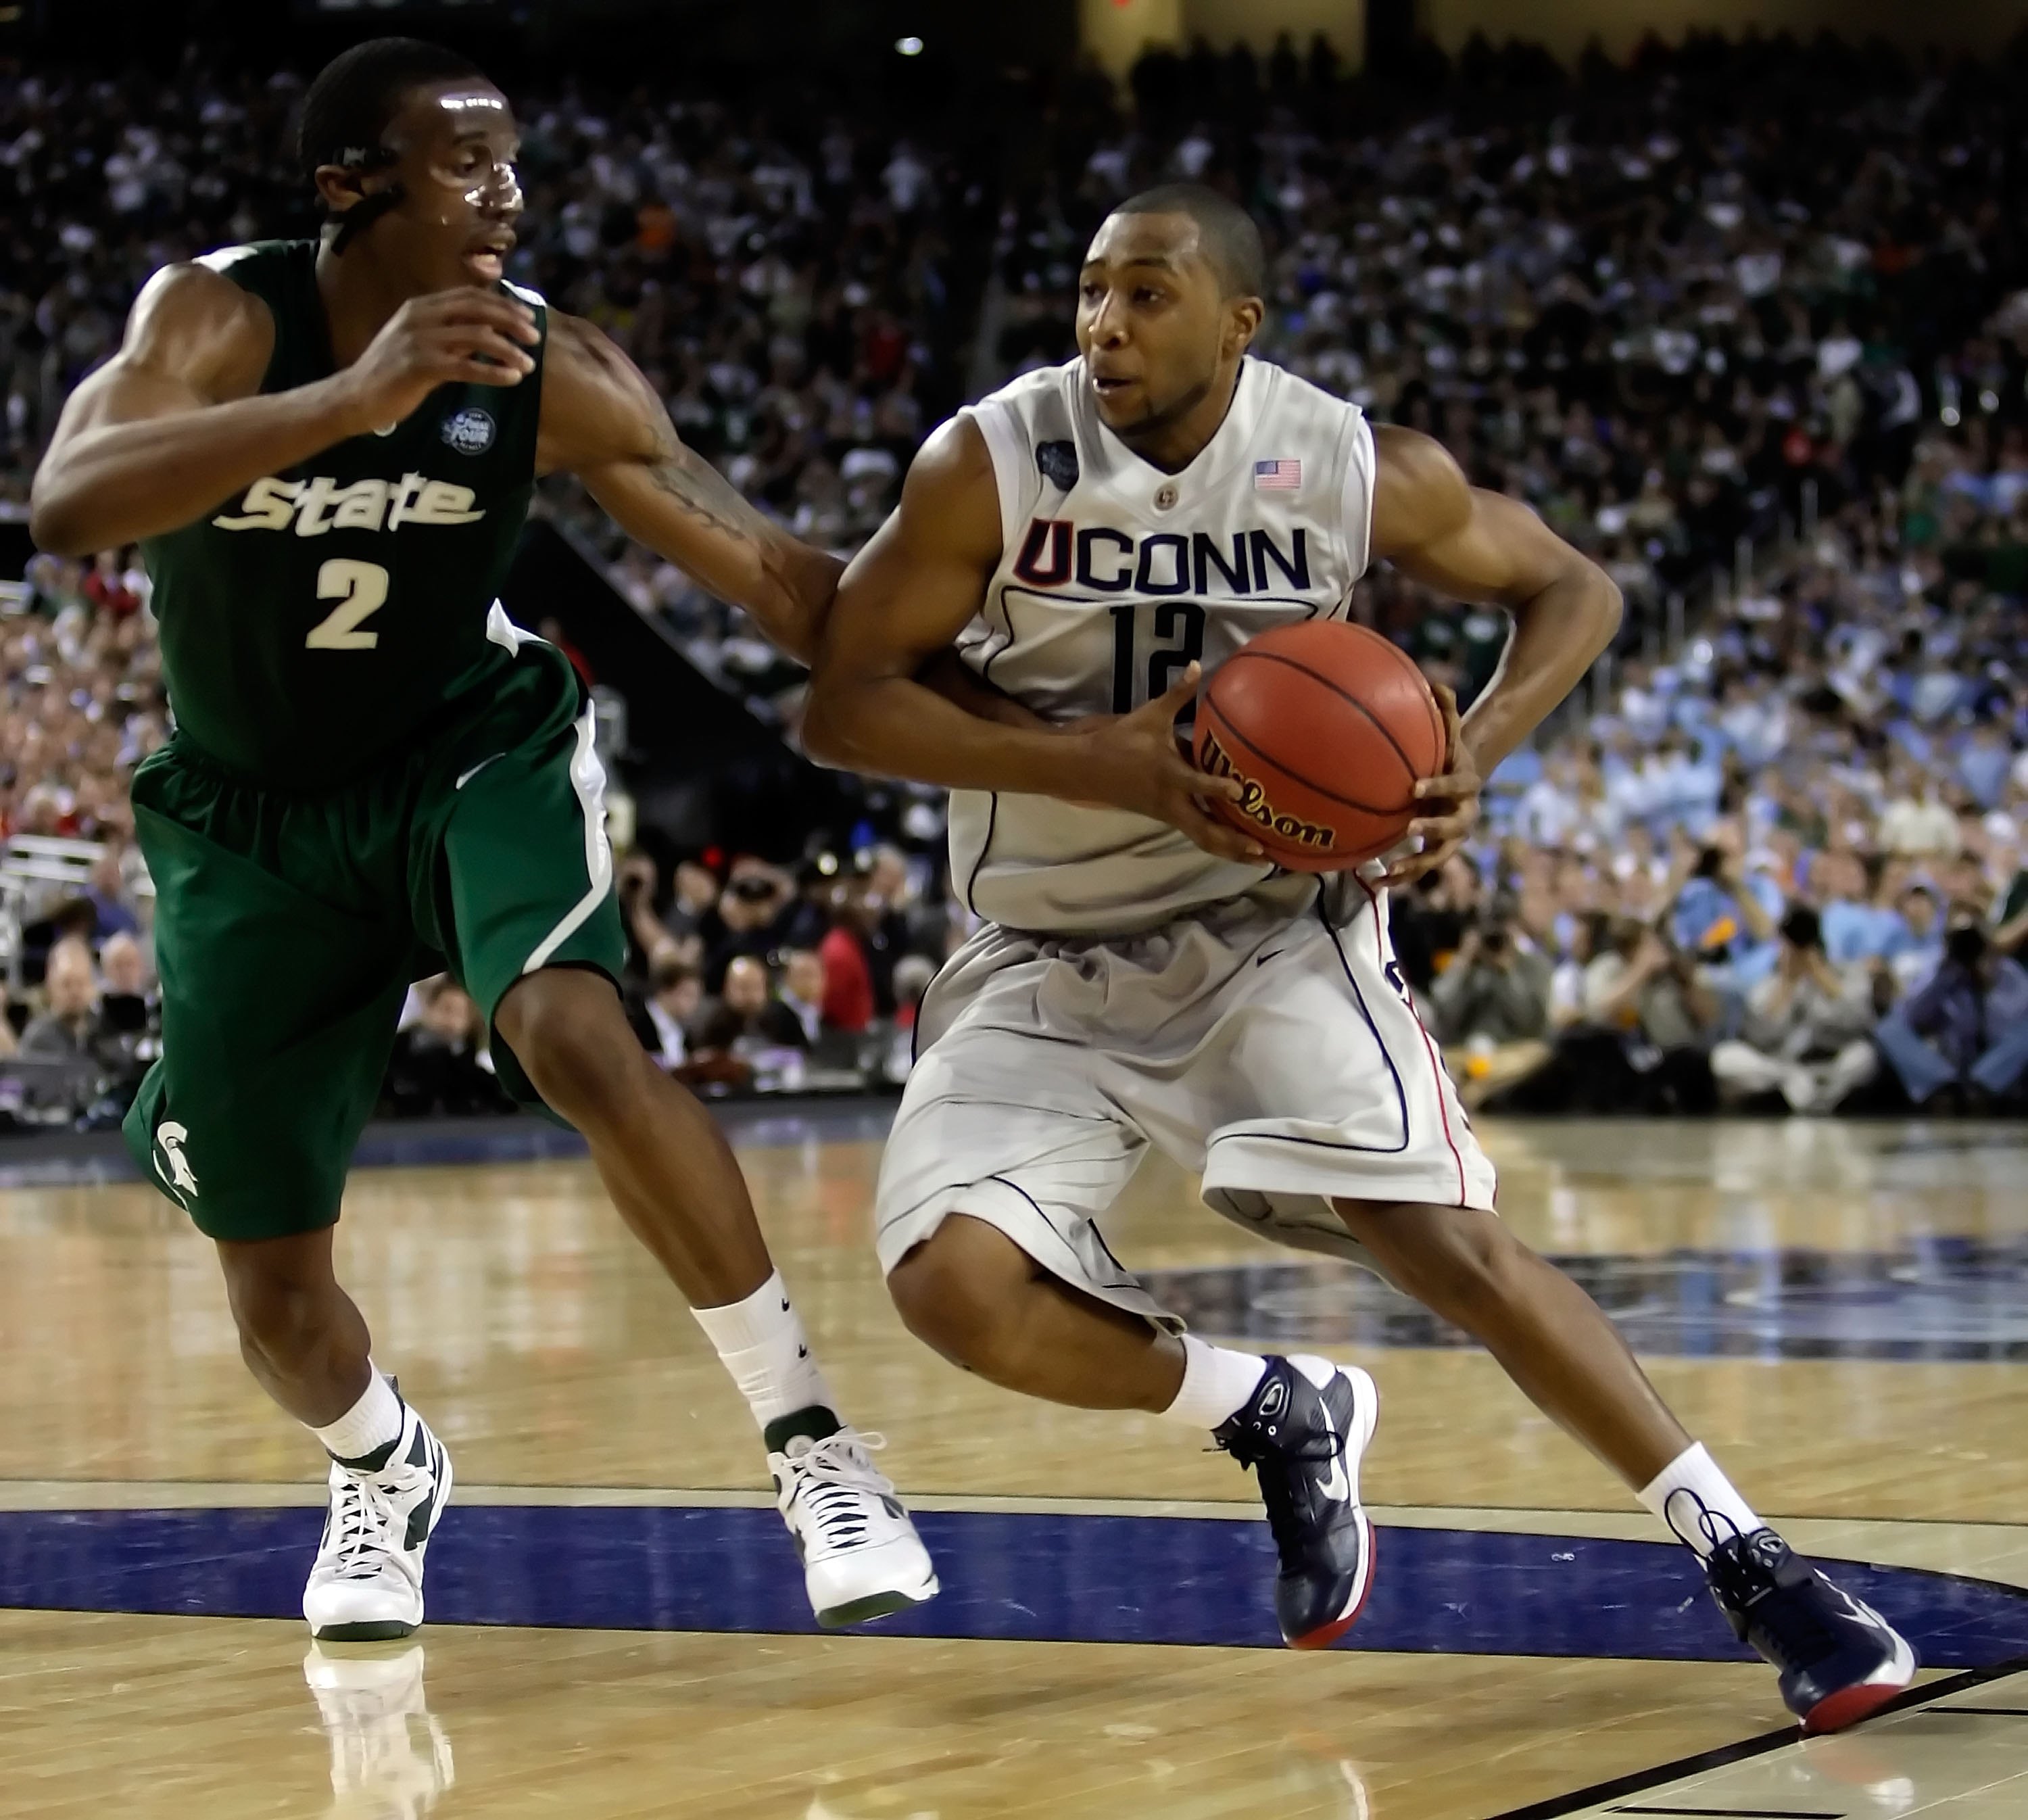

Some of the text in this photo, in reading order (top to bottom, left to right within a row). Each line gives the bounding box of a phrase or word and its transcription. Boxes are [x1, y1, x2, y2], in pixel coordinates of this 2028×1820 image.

[1013, 518, 1311, 595] UCONN
[306, 558, 389, 649] 2
[1109, 602, 1206, 724] 12
